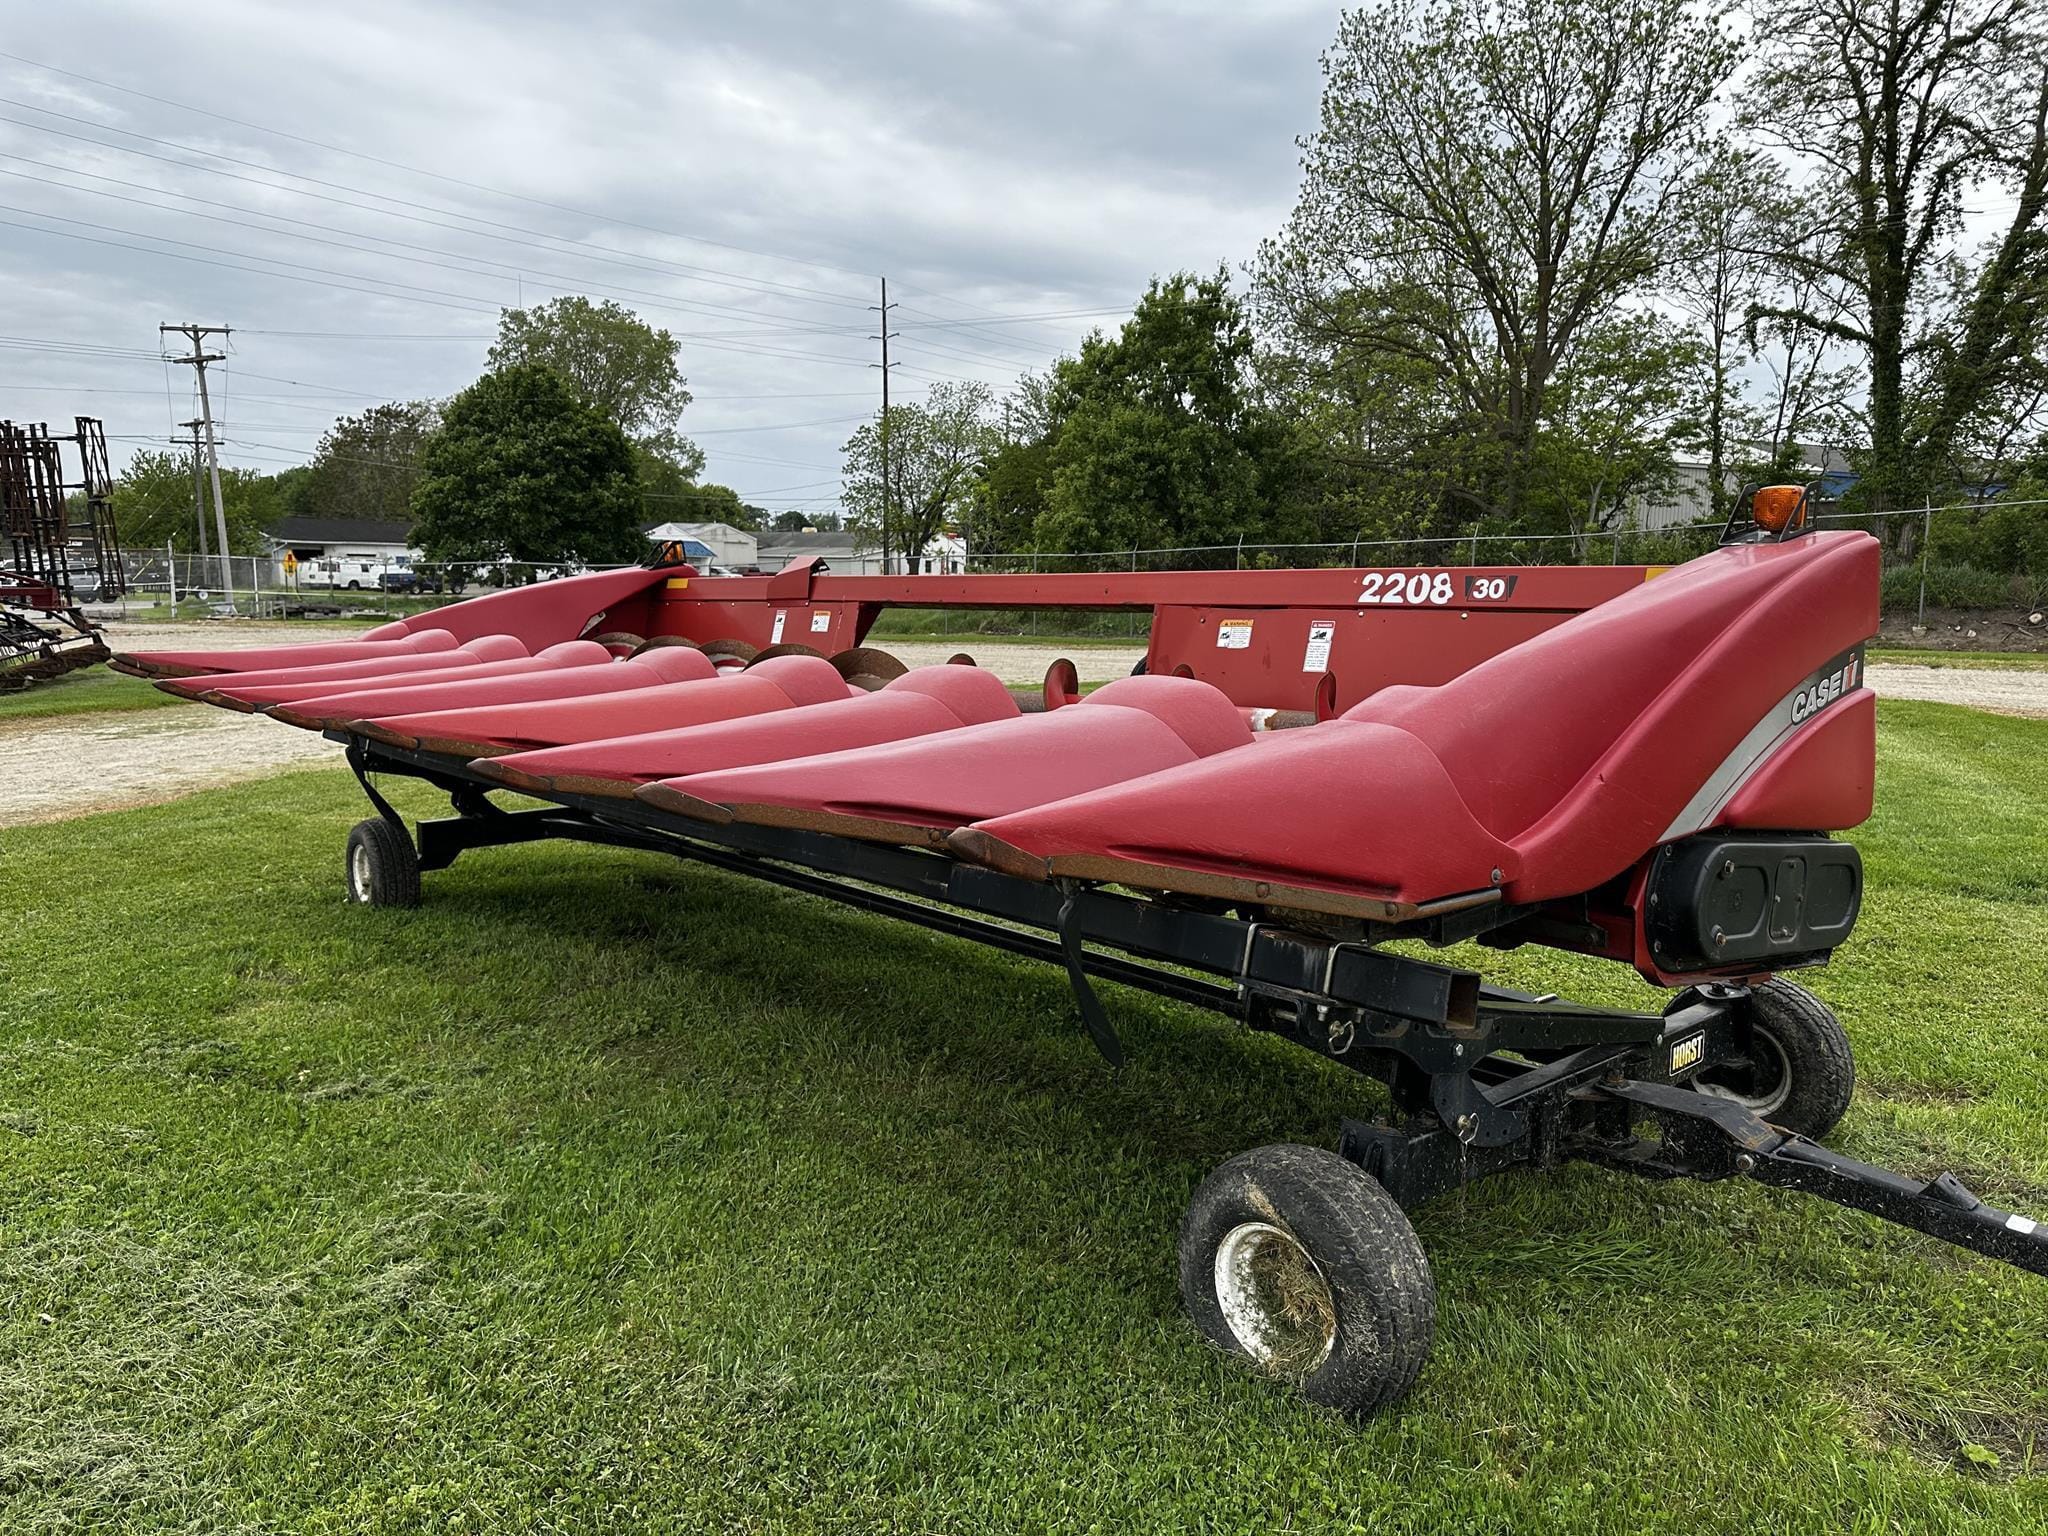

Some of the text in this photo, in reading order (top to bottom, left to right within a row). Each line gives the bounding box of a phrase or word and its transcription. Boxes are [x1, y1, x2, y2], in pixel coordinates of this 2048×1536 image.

[1357, 572, 1506, 605] 2208 30
[1791, 669, 1842, 724] CASE
[1672, 1035, 1703, 1071] HORST
